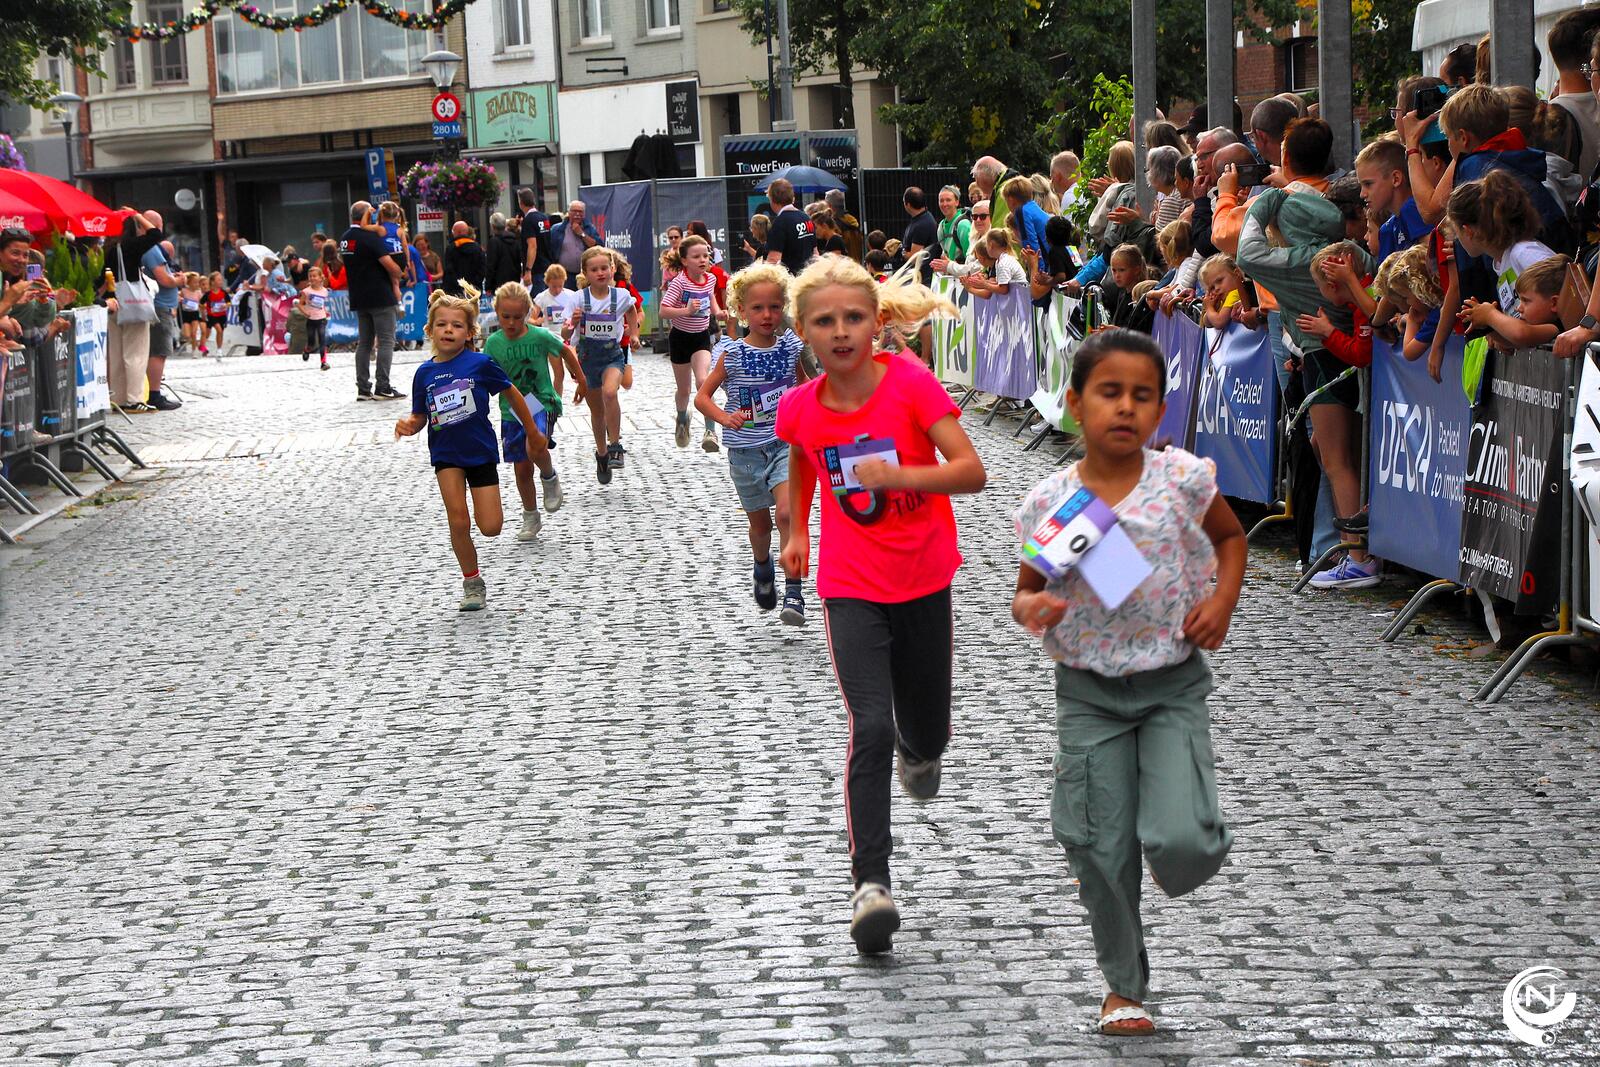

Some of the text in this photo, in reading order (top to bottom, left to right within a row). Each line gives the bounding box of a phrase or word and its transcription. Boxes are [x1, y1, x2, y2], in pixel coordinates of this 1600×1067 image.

[486, 91, 537, 124] EMMY'S
[433, 124, 461, 135] 280 M
[368, 151, 380, 175] P
[736, 160, 791, 174] TowerEye
[816, 155, 851, 169] TowerEye
[605, 229, 632, 249] Herentals
[590, 324, 613, 332] 0019
[507, 343, 543, 361] CELTICS
[439, 394, 456, 404] 0017
[1230, 377, 1264, 405] Packed
[1379, 400, 1432, 495] DECA
[1438, 421, 1461, 457] Packed
[1465, 420, 1508, 492] Clima
[1430, 466, 1442, 498] to
[1461, 495, 1498, 519] REATOR
